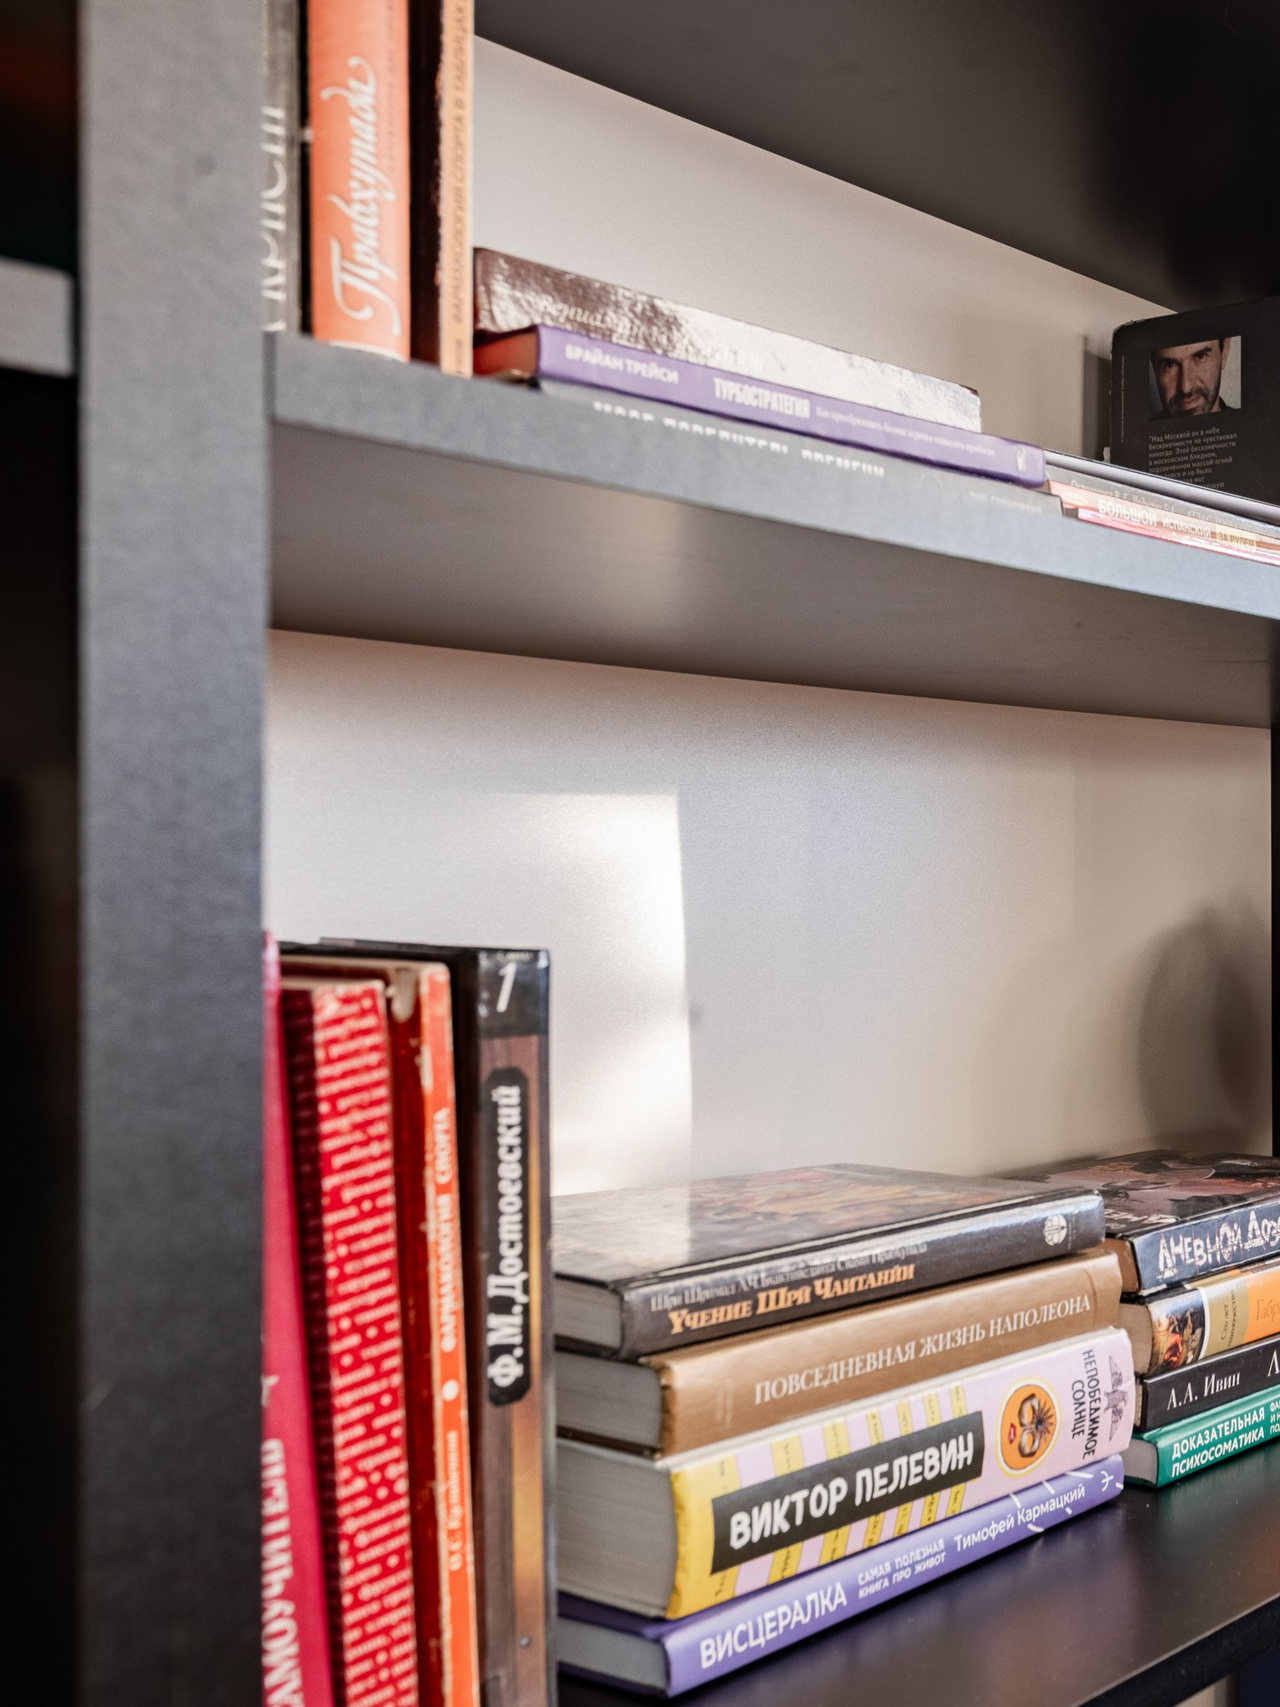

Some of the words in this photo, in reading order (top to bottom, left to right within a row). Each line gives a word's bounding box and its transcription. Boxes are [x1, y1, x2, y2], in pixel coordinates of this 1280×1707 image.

[626, 357, 680, 385] ТРЕЙСИ
[1098, 499, 1158, 527] БОЛЬШОЙ
[1162, 516, 1212, 539] ИСПАНСКИЙ
[433, 1107, 453, 1185] СПОРТА
[435, 1193, 458, 1353] ФАРМАКОЛОГИЯ
[754, 1340, 917, 1406] ПОВСЕДНЕВНАЯ
[919, 1325, 987, 1368] ЖИЗНЬ
[987, 1294, 1092, 1339] НАПОЛЕОНА
[1070, 1379, 1086, 1440] СОЛНЦЕ
[1081, 1349, 1097, 1462] НЕПОБЕДИМОЕ
[1202, 1371, 1242, 1399] Ивин
[1171, 1406, 1266, 1460] ДОКАЗАТЕЛЬНАЯ
[1270, 1413, 1276, 1424] И
[1171, 1426, 1266, 1478] ПСИХОСОМАТИКА
[728, 1476, 848, 1551] ВИКТОР
[854, 1431, 975, 1507] ПЕЛЕВИН
[953, 1511, 1016, 1554] Тимофей
[1016, 1482, 1087, 1526] Кармацкий
[857, 1561, 892, 1587] САМАЯ
[893, 1538, 946, 1569] ПОЛЕЗНАЯ
[857, 1577, 890, 1600] КНИГА
[891, 1568, 911, 1585] ПРО
[913, 1552, 947, 1576] ЖИВОТ
[699, 1581, 848, 1670] ВИСЦЕРАЛКА
